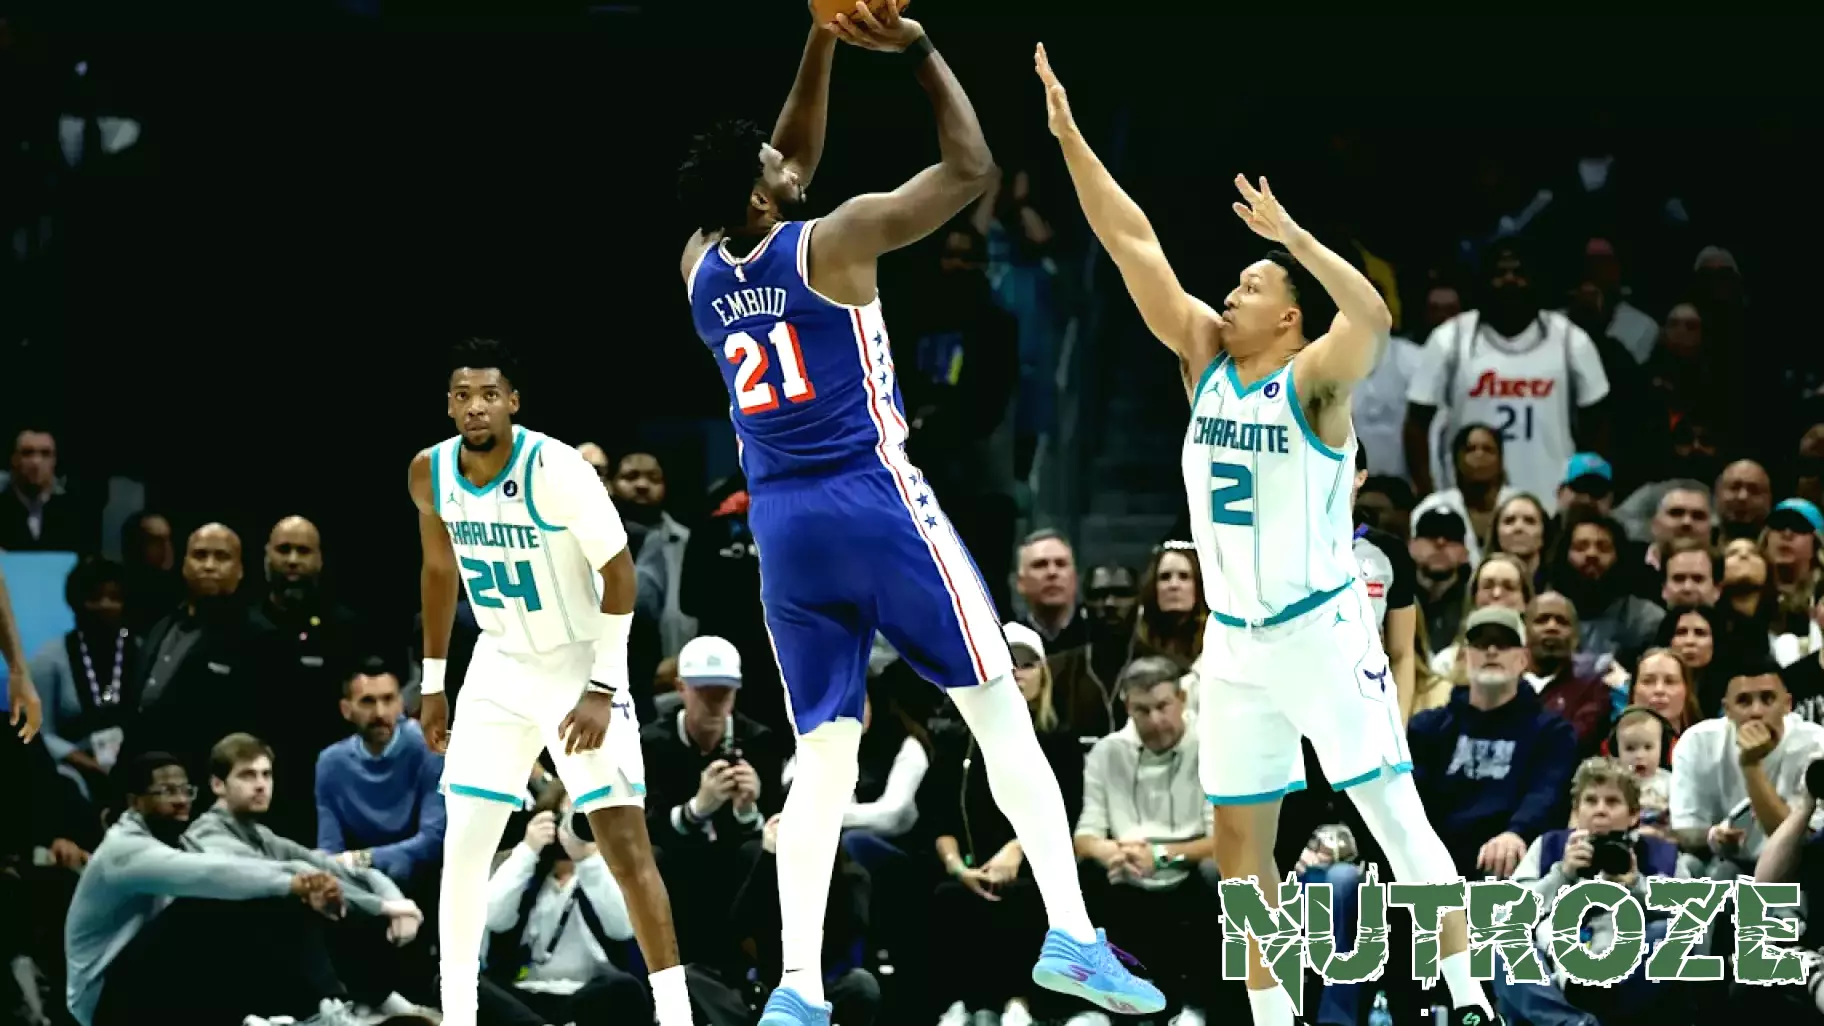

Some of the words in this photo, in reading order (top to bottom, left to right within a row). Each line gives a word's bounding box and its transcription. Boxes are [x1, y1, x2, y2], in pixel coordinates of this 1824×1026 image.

[711, 286, 787, 327] EMBIID
[724, 321, 817, 416] 21
[1193, 416, 1289, 454] CHARLOTTE
[1497, 405, 1534, 442] 21
[1211, 462, 1254, 527] 2
[444, 521, 540, 549] HARLOTTE
[460, 555, 543, 613] 24
